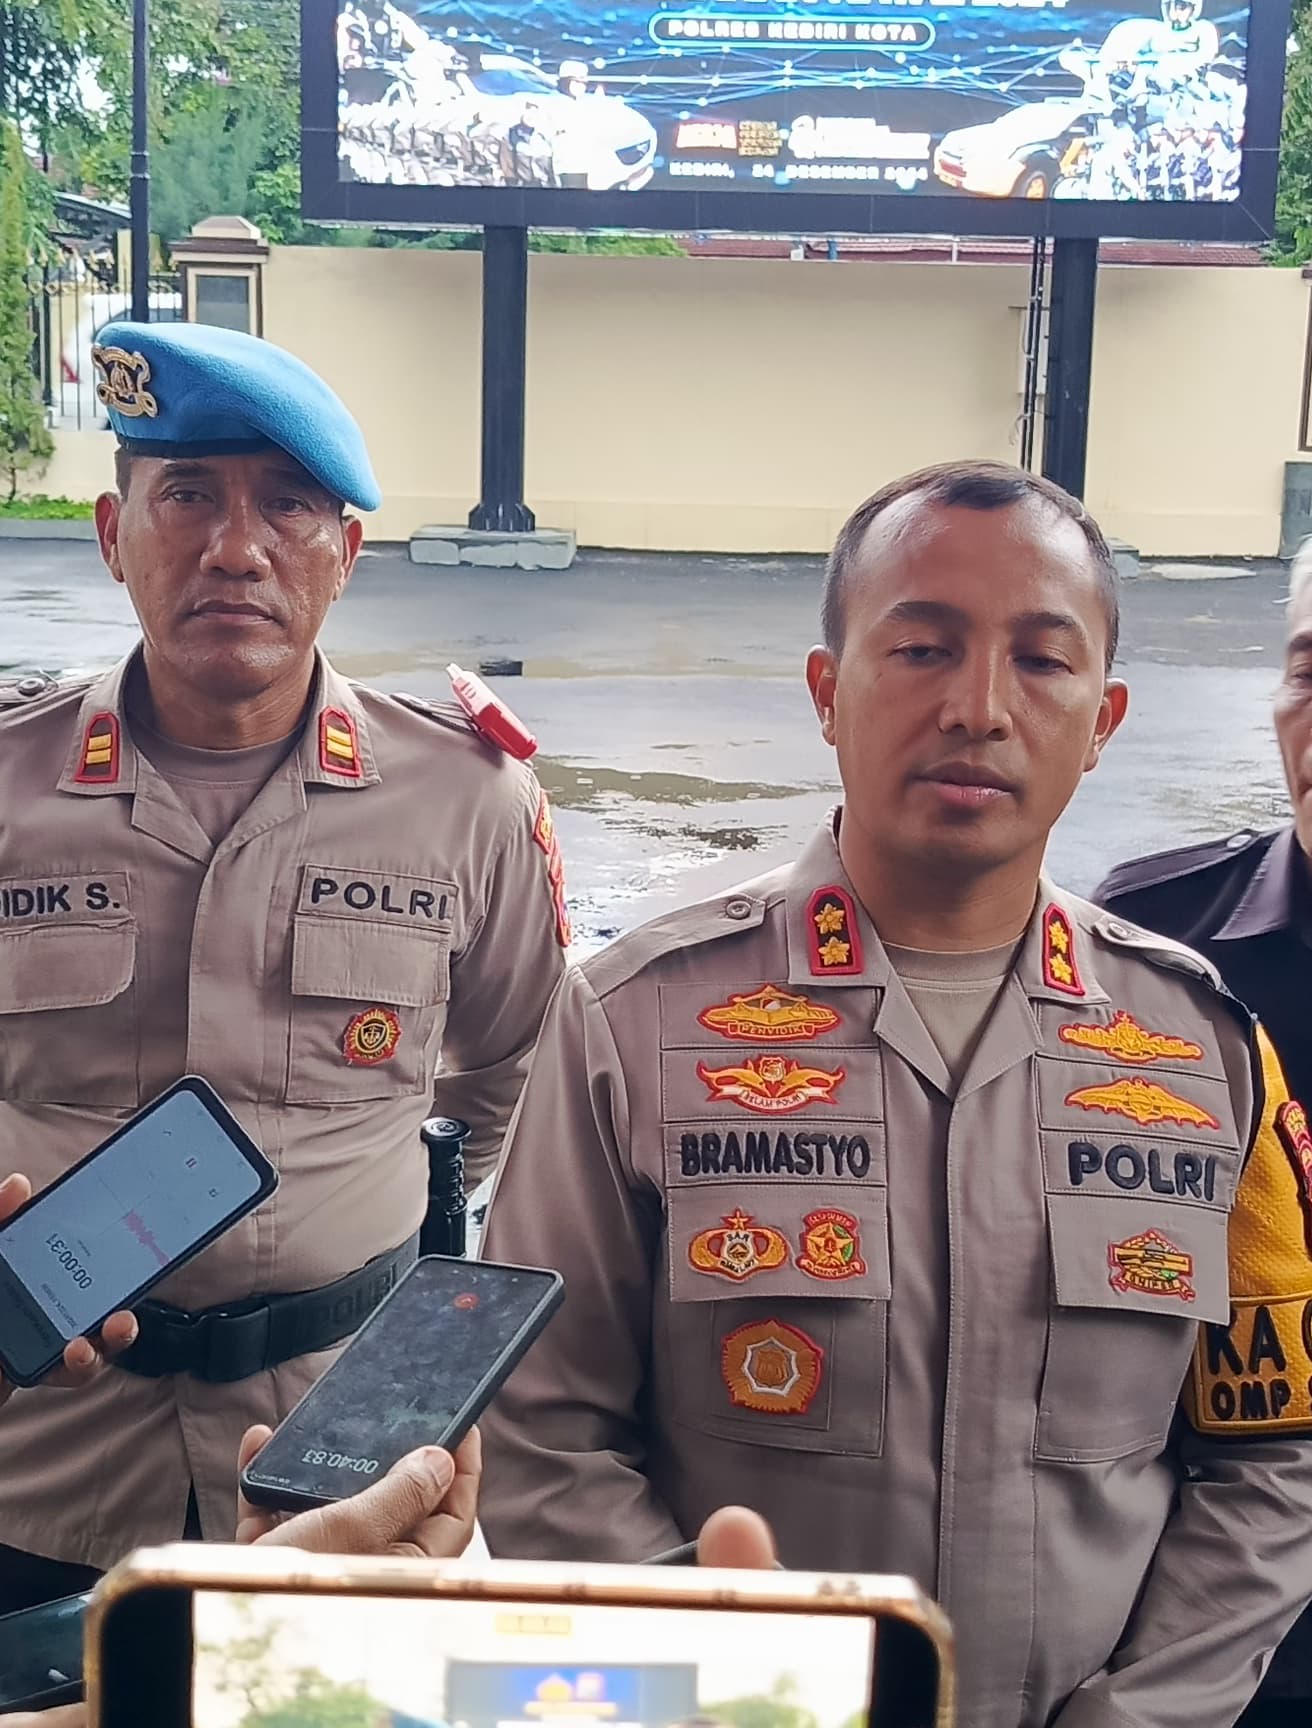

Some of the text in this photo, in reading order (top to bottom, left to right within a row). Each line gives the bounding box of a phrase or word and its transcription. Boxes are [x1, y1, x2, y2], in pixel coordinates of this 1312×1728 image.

[668, 19, 917, 41] POLRES KEDIRI KOTA
[85, 882, 120, 912] S.
[309, 876, 449, 921] POLRI
[679, 1131, 870, 1179] BRAMASTYO
[1067, 1141, 1216, 1201] POLRI
[45, 1233, 93, 1290] 00:00:31
[1206, 1305, 1287, 1375] KA
[1211, 1378, 1292, 1421] OMP
[302, 1449, 379, 1474] 00:40.83
